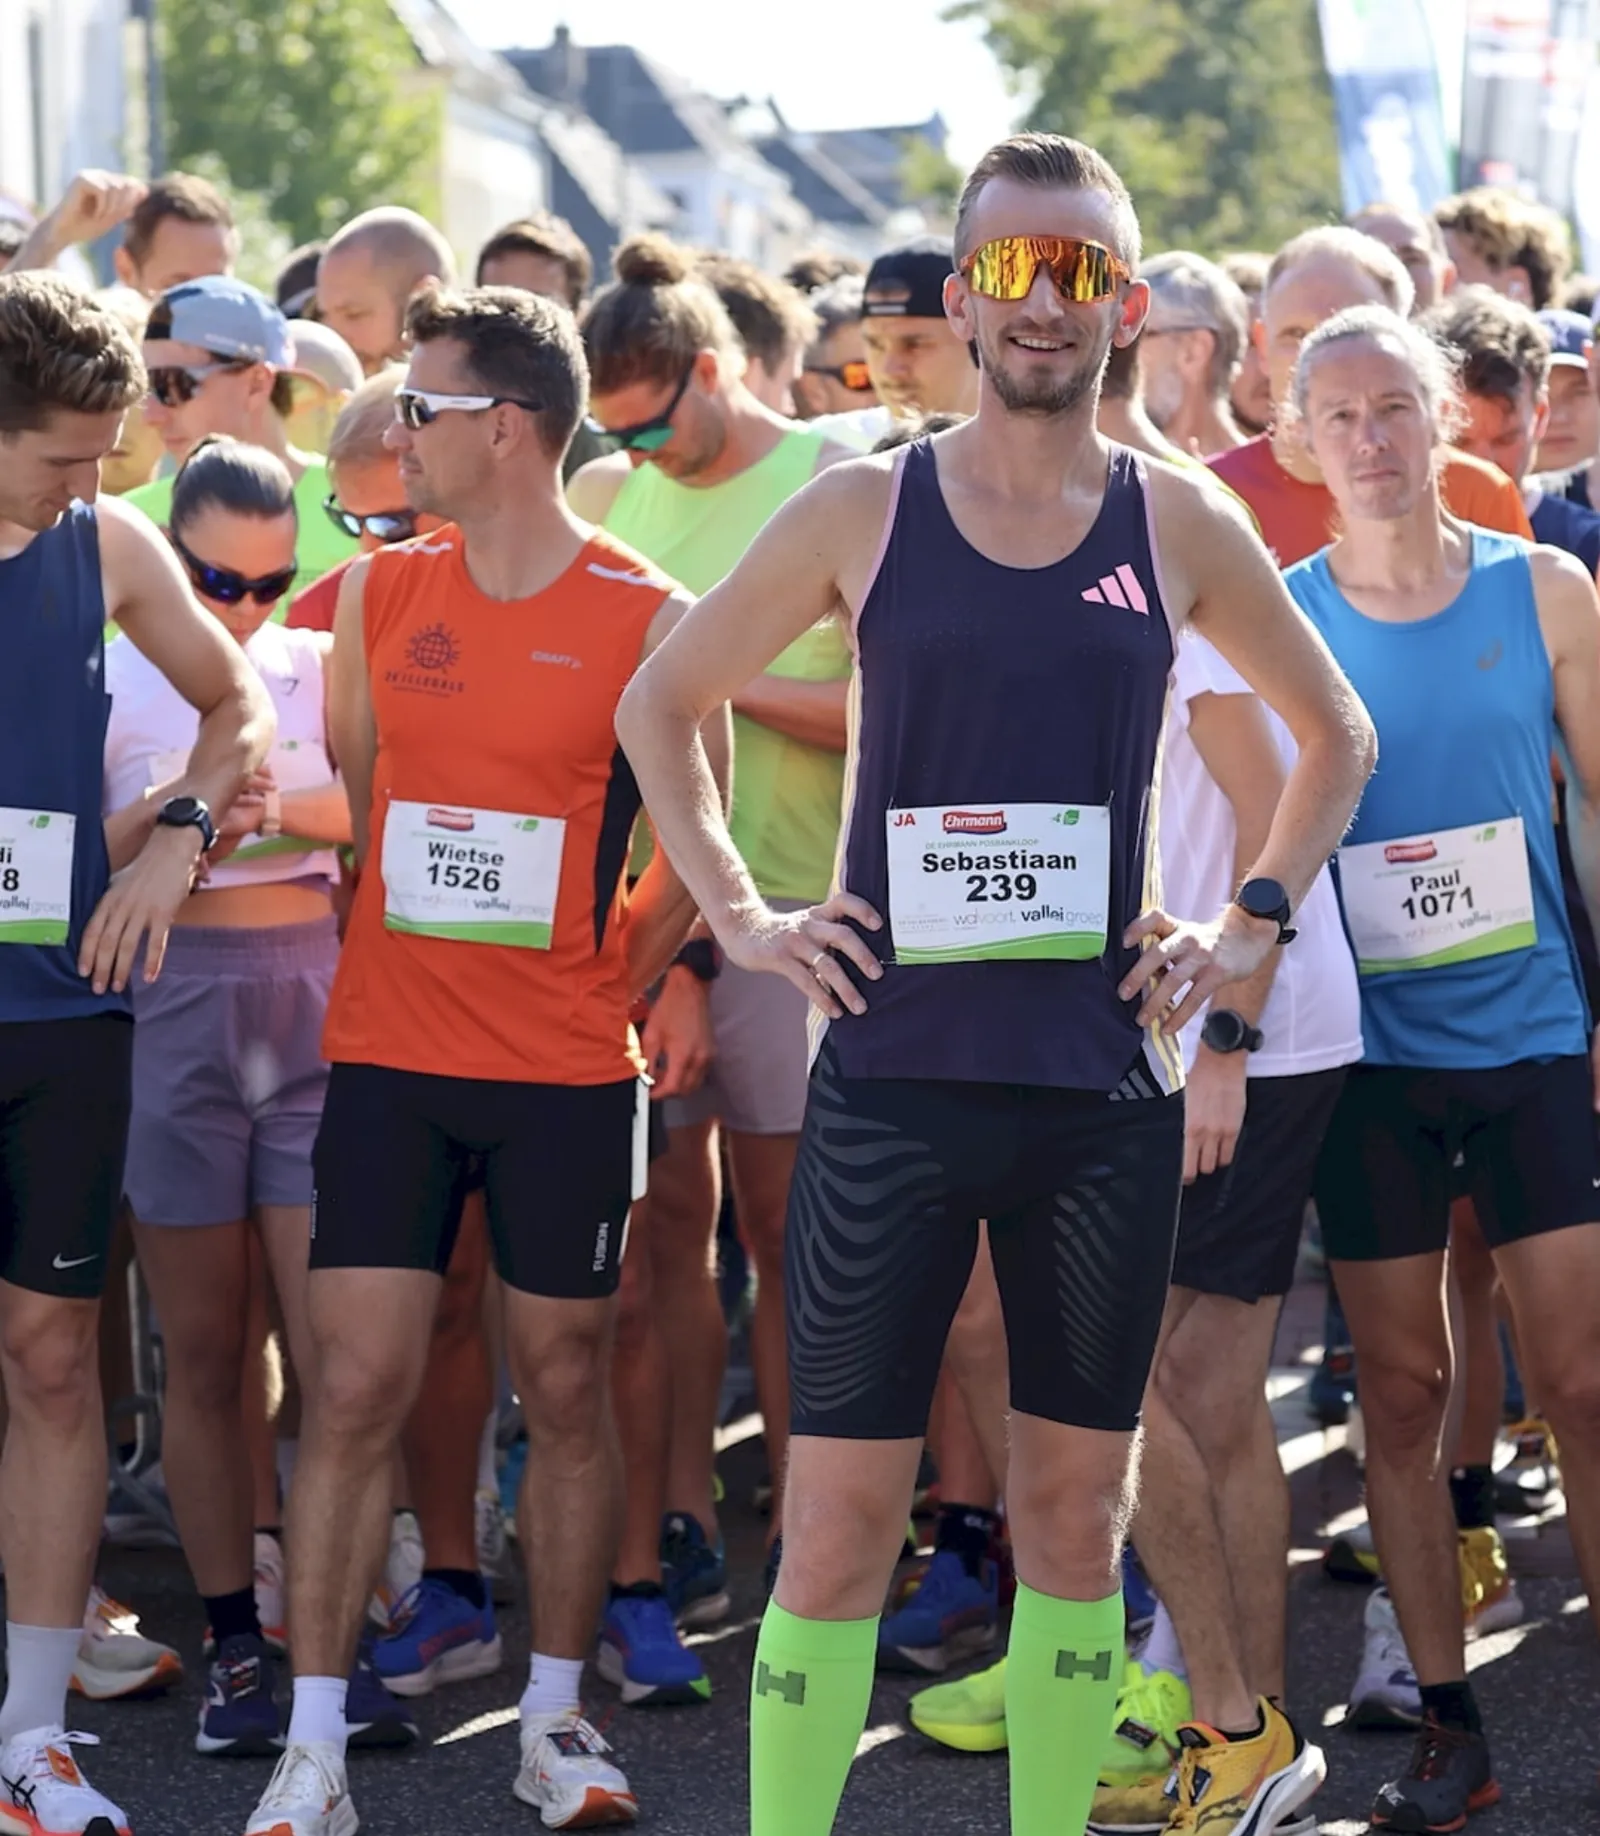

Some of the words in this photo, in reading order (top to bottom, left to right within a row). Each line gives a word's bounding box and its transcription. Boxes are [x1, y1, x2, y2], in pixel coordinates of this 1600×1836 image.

[894, 813, 916, 827] JA
[944, 812, 1003, 828] Ehrmann
[428, 841, 504, 866] Wietse
[922, 850, 1077, 872] Sebastiaan
[427, 862, 501, 892] 1526
[966, 873, 1037, 902] 239
[1410, 869, 1460, 892] Paul
[1401, 886, 1474, 920] 1071
